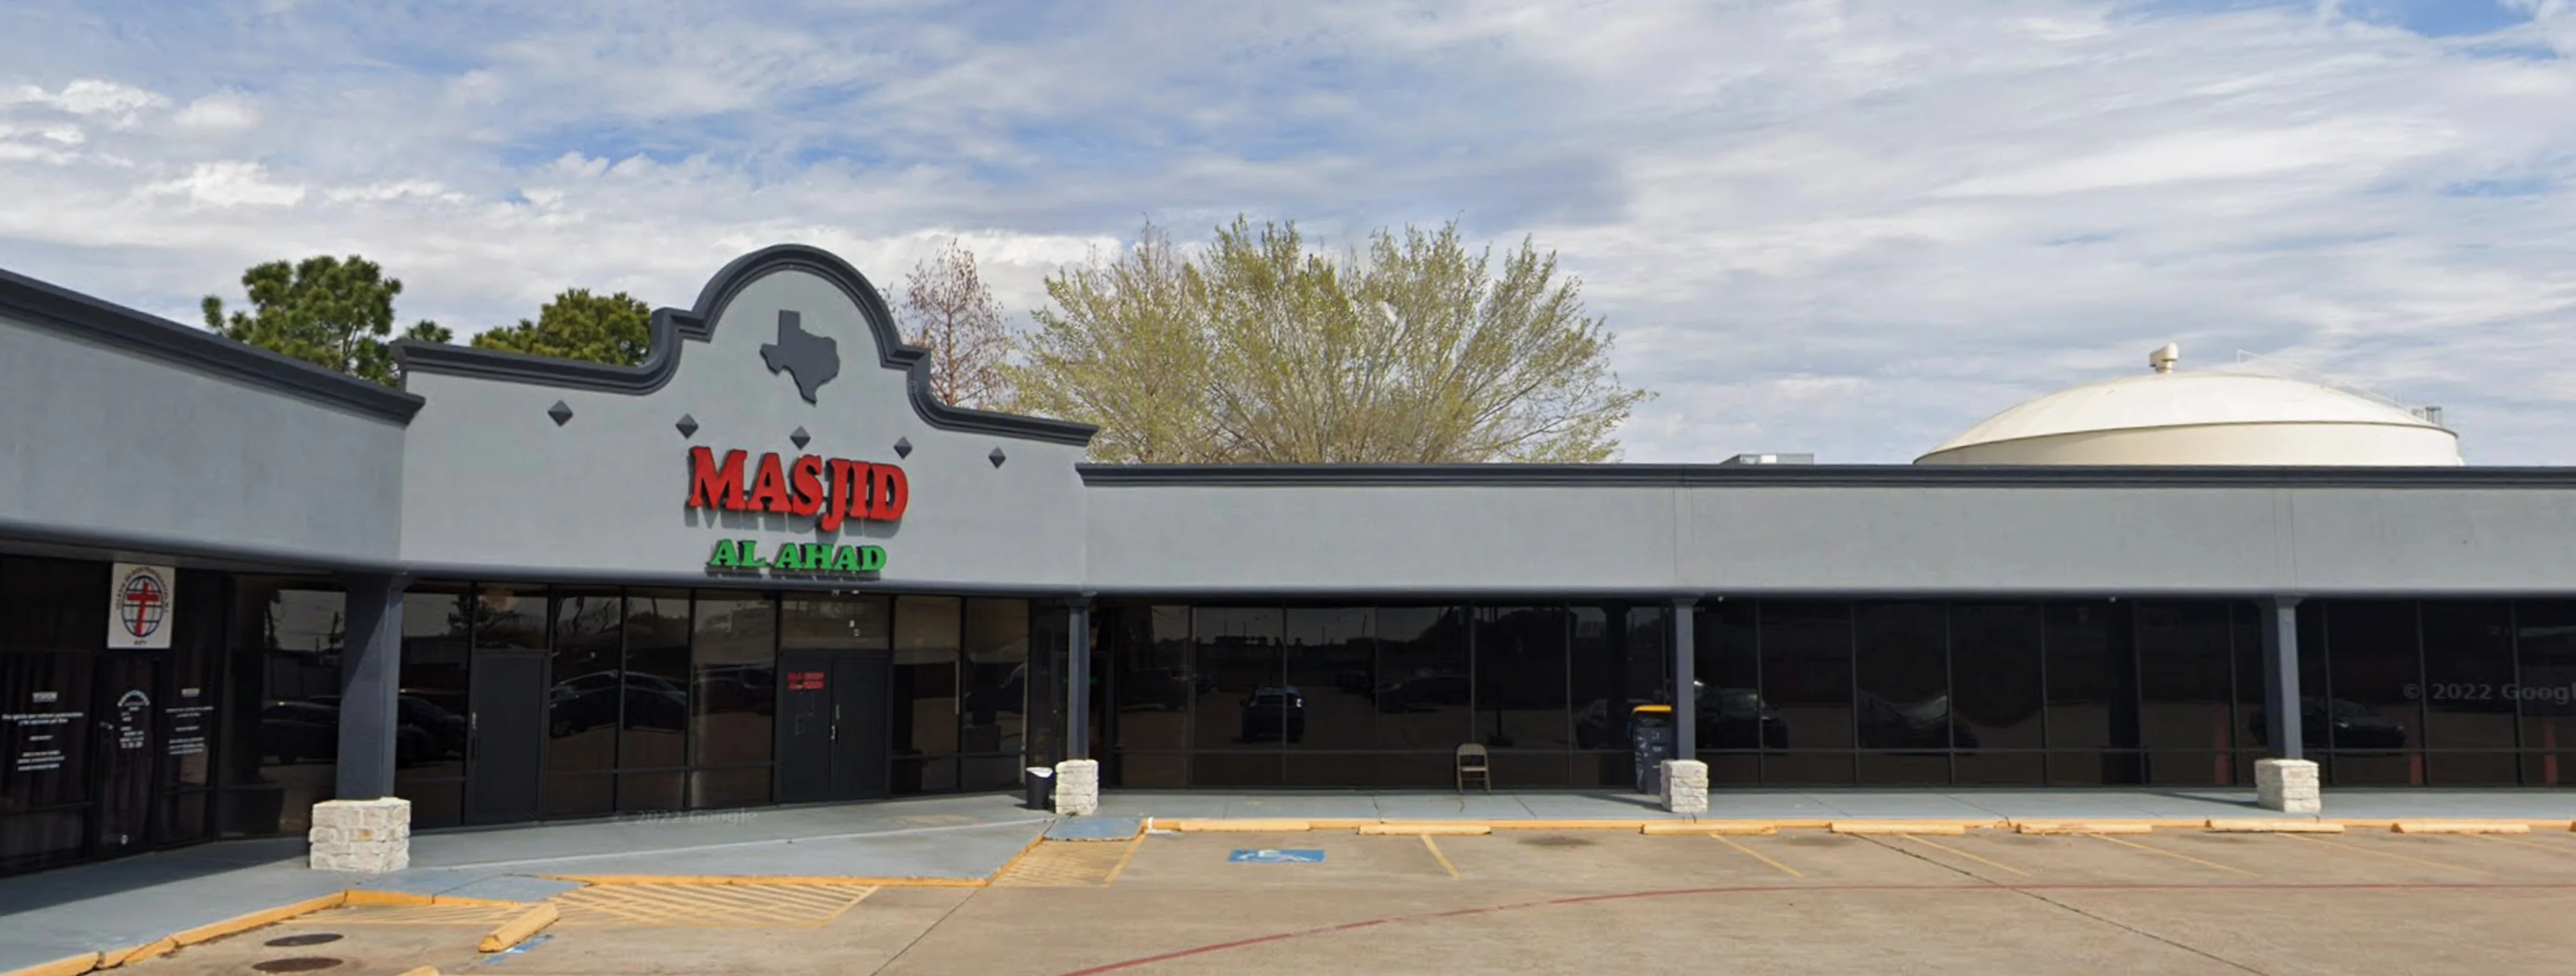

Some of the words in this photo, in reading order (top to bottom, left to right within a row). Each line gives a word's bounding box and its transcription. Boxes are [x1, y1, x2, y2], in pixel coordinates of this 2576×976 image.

[688, 445, 910, 532] MASJID
[709, 538, 766, 568] AL
[774, 542, 887, 572] AHAD
